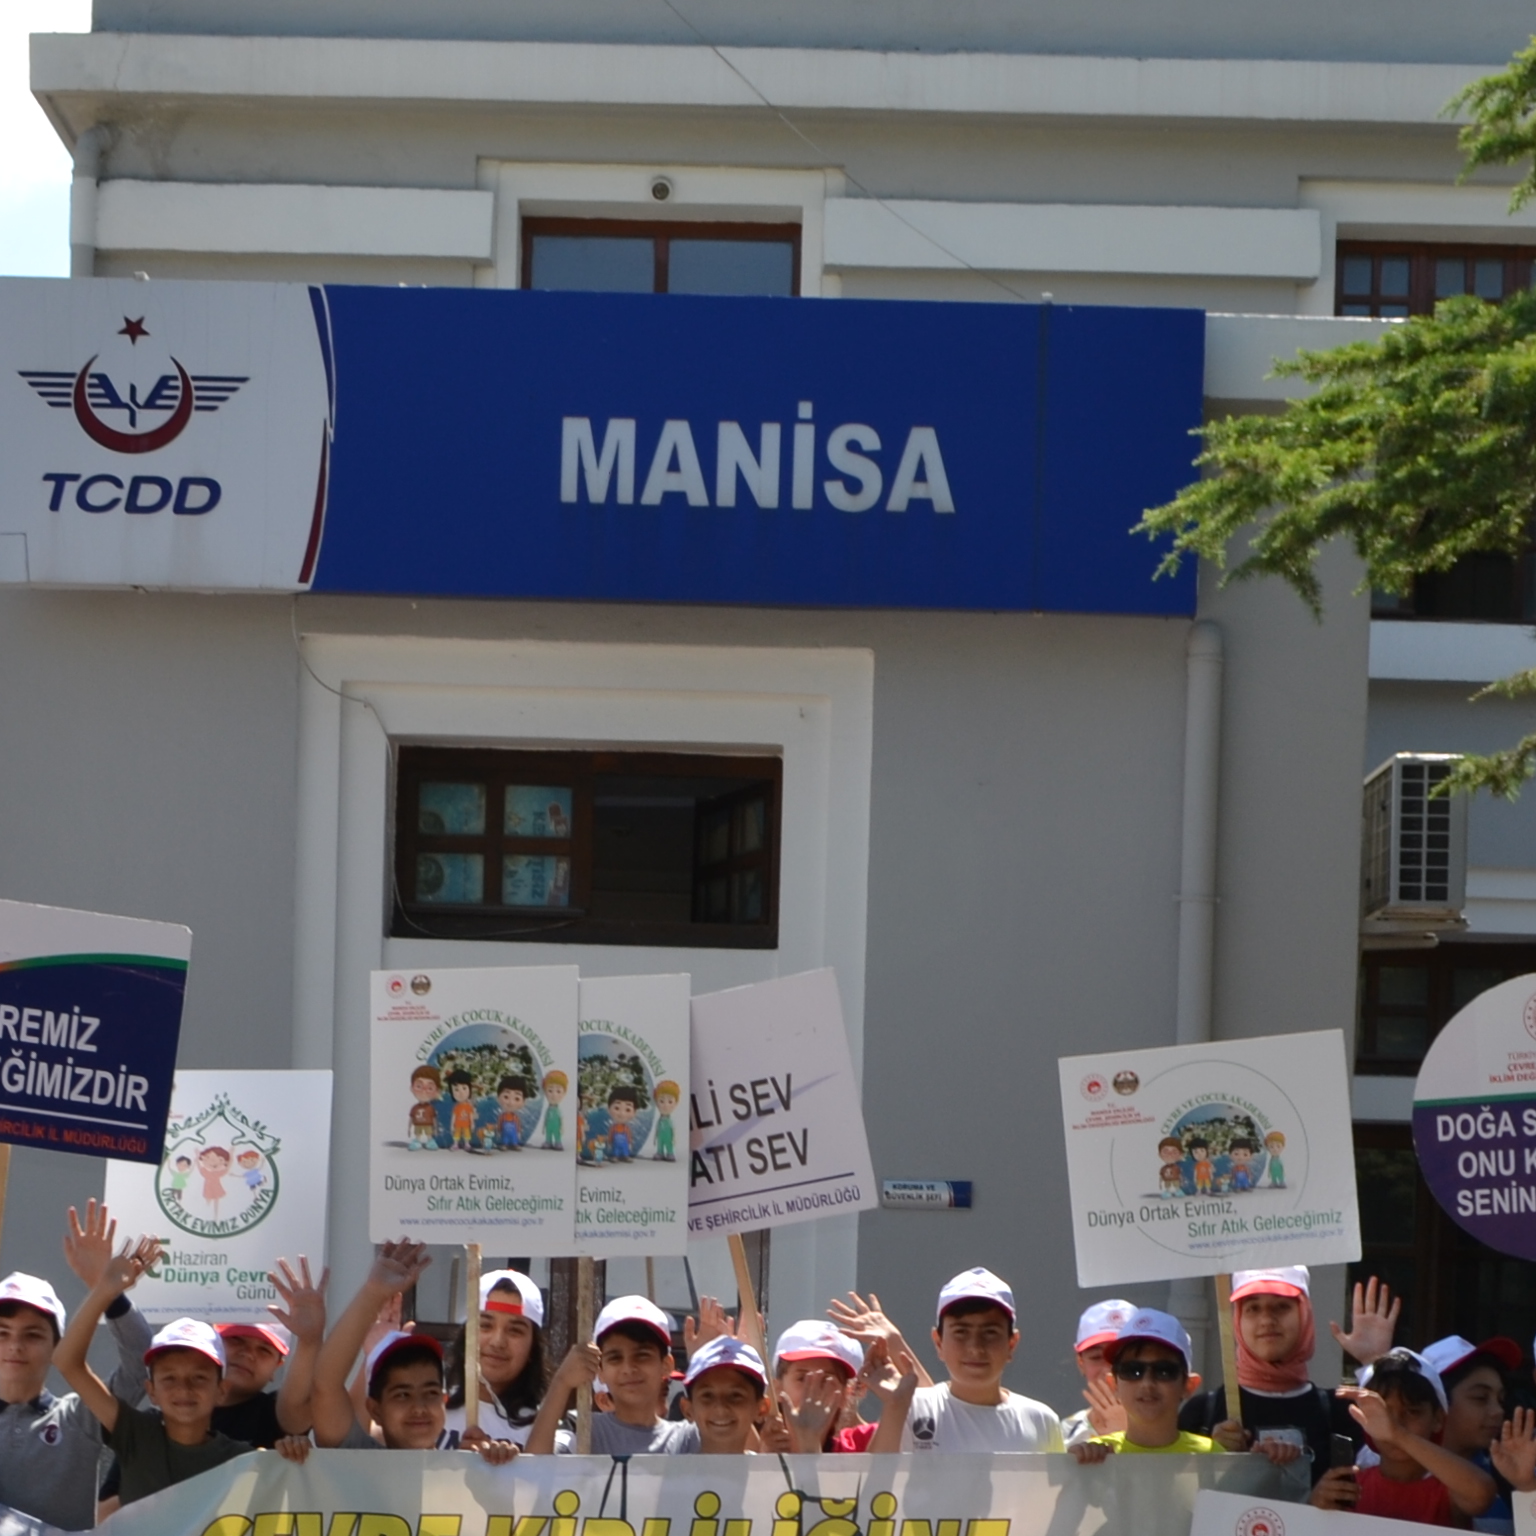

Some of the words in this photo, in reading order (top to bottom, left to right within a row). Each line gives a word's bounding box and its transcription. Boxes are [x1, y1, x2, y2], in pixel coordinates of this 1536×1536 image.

[558, 400, 956, 516] MANİSA
[40, 470, 223, 518] TCDD
[416, 1022, 446, 1062] ÇEVRE
[444, 1015, 461, 1030] VE
[461, 1009, 503, 1026] ÇOCUK
[576, 1020, 614, 1032] OCUK
[1489, 1072, 1515, 1084] İKLİM
[690, 1080, 722, 1130] Lİ
[730, 1073, 792, 1121] SEV
[1437, 1106, 1516, 1142] DOĞA
[49, 1125, 59, 1142] İL
[63, 1126, 147, 1154] MÜDÜRLÜĞÜ
[690, 1142, 739, 1188] ATI
[746, 1128, 808, 1175] SEV
[1458, 1149, 1515, 1178] ONU
[385, 1175, 426, 1194] Dünya
[430, 1175, 464, 1190] Ortak
[468, 1174, 515, 1193] Evimiz,
[580, 1187, 626, 1205] Evimiz,
[1457, 1180, 1536, 1216] SENİN
[191, 1218, 239, 1234] EVİMİZ
[240, 1188, 273, 1224] DÜNYA
[427, 1196, 452, 1211] Sıfır
[456, 1196, 481, 1211] Atık
[485, 1196, 564, 1214] Geleceğimiz
[575, 1208, 591, 1224] tık
[597, 1208, 676, 1227] Geleceğimiz
[688, 1217, 703, 1232] VE
[705, 1201, 772, 1230] ŞEHİRCİLİK
[773, 1199, 784, 1215] İL
[786, 1185, 861, 1213] MÜDÜRLÜĞÜ
[1088, 1210, 1134, 1228] Dünya
[1140, 1203, 1180, 1222] Ortak
[1185, 1199, 1238, 1218] Evimiz,
[574, 1229, 656, 1241] cukakademisi.gov.tr
[1188, 1222, 1216, 1238] Sıfır
[1221, 1216, 1248, 1235] Atık
[1253, 1210, 1342, 1232] Geleceğimiz
[173, 1251, 228, 1266] Haziran
[165, 1268, 220, 1286] Dünya
[237, 1285, 276, 1300] Günü
